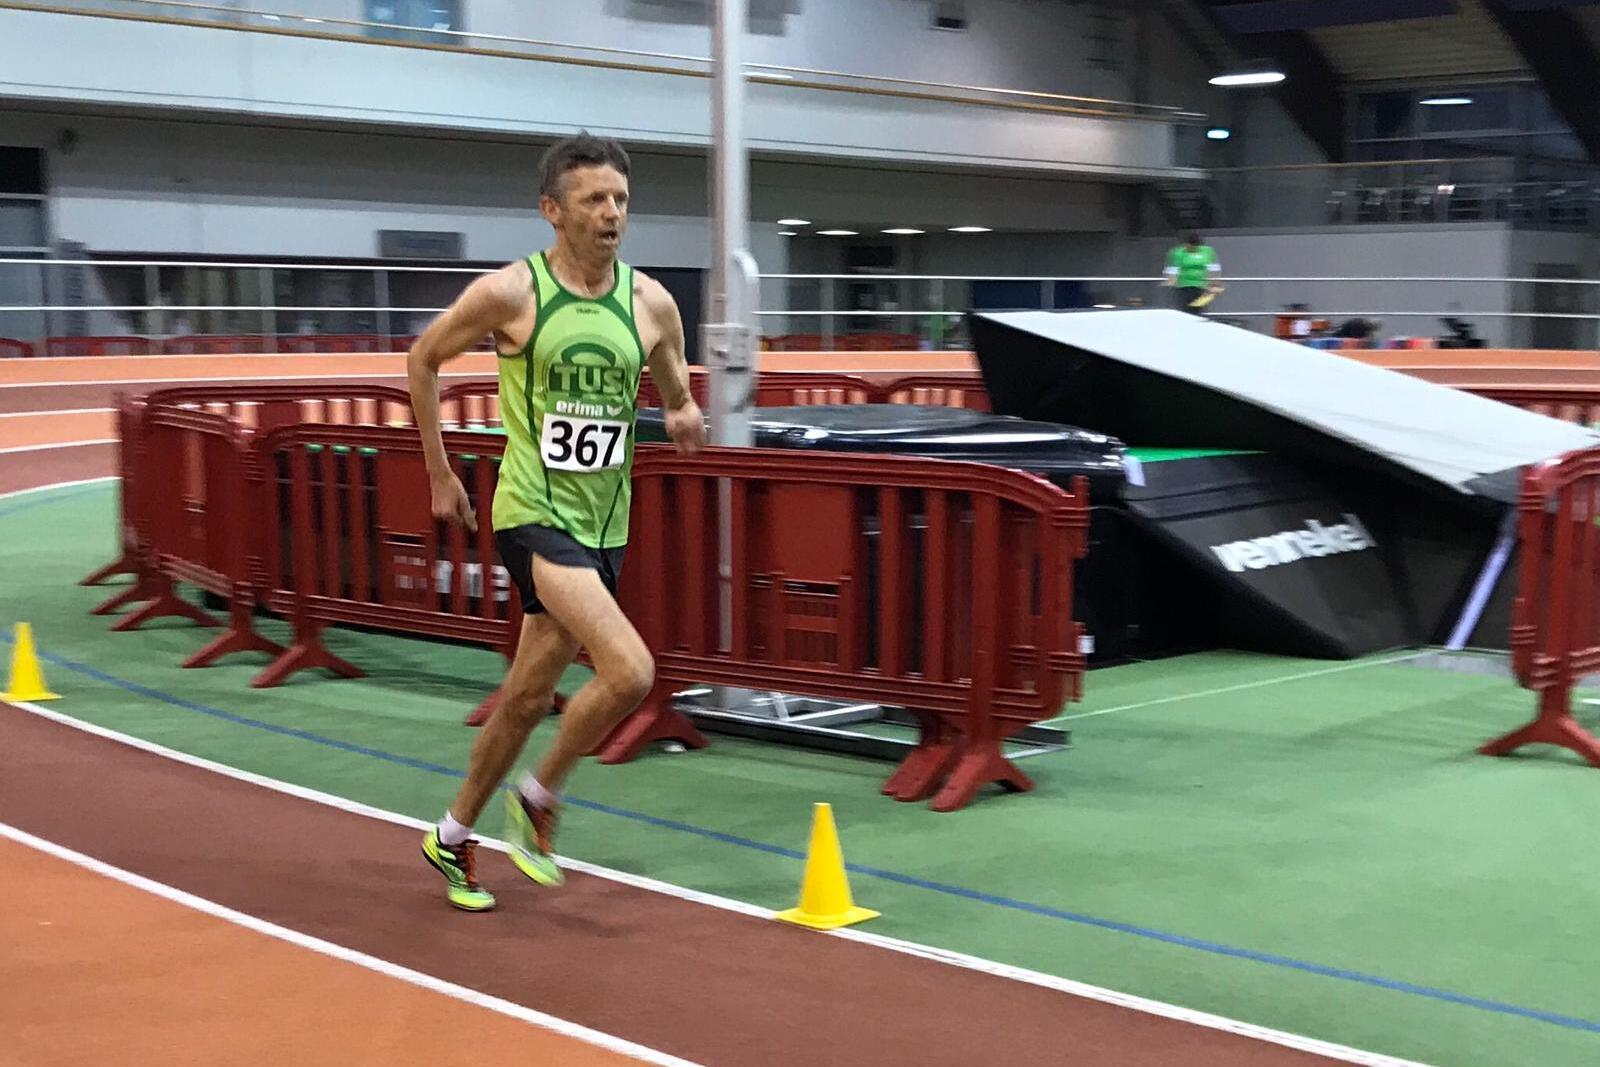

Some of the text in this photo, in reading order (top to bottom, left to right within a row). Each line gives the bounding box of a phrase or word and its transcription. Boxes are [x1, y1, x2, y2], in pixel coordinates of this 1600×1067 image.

[554, 364, 623, 394] TUS
[556, 400, 604, 417] erima
[547, 420, 623, 468] 367
